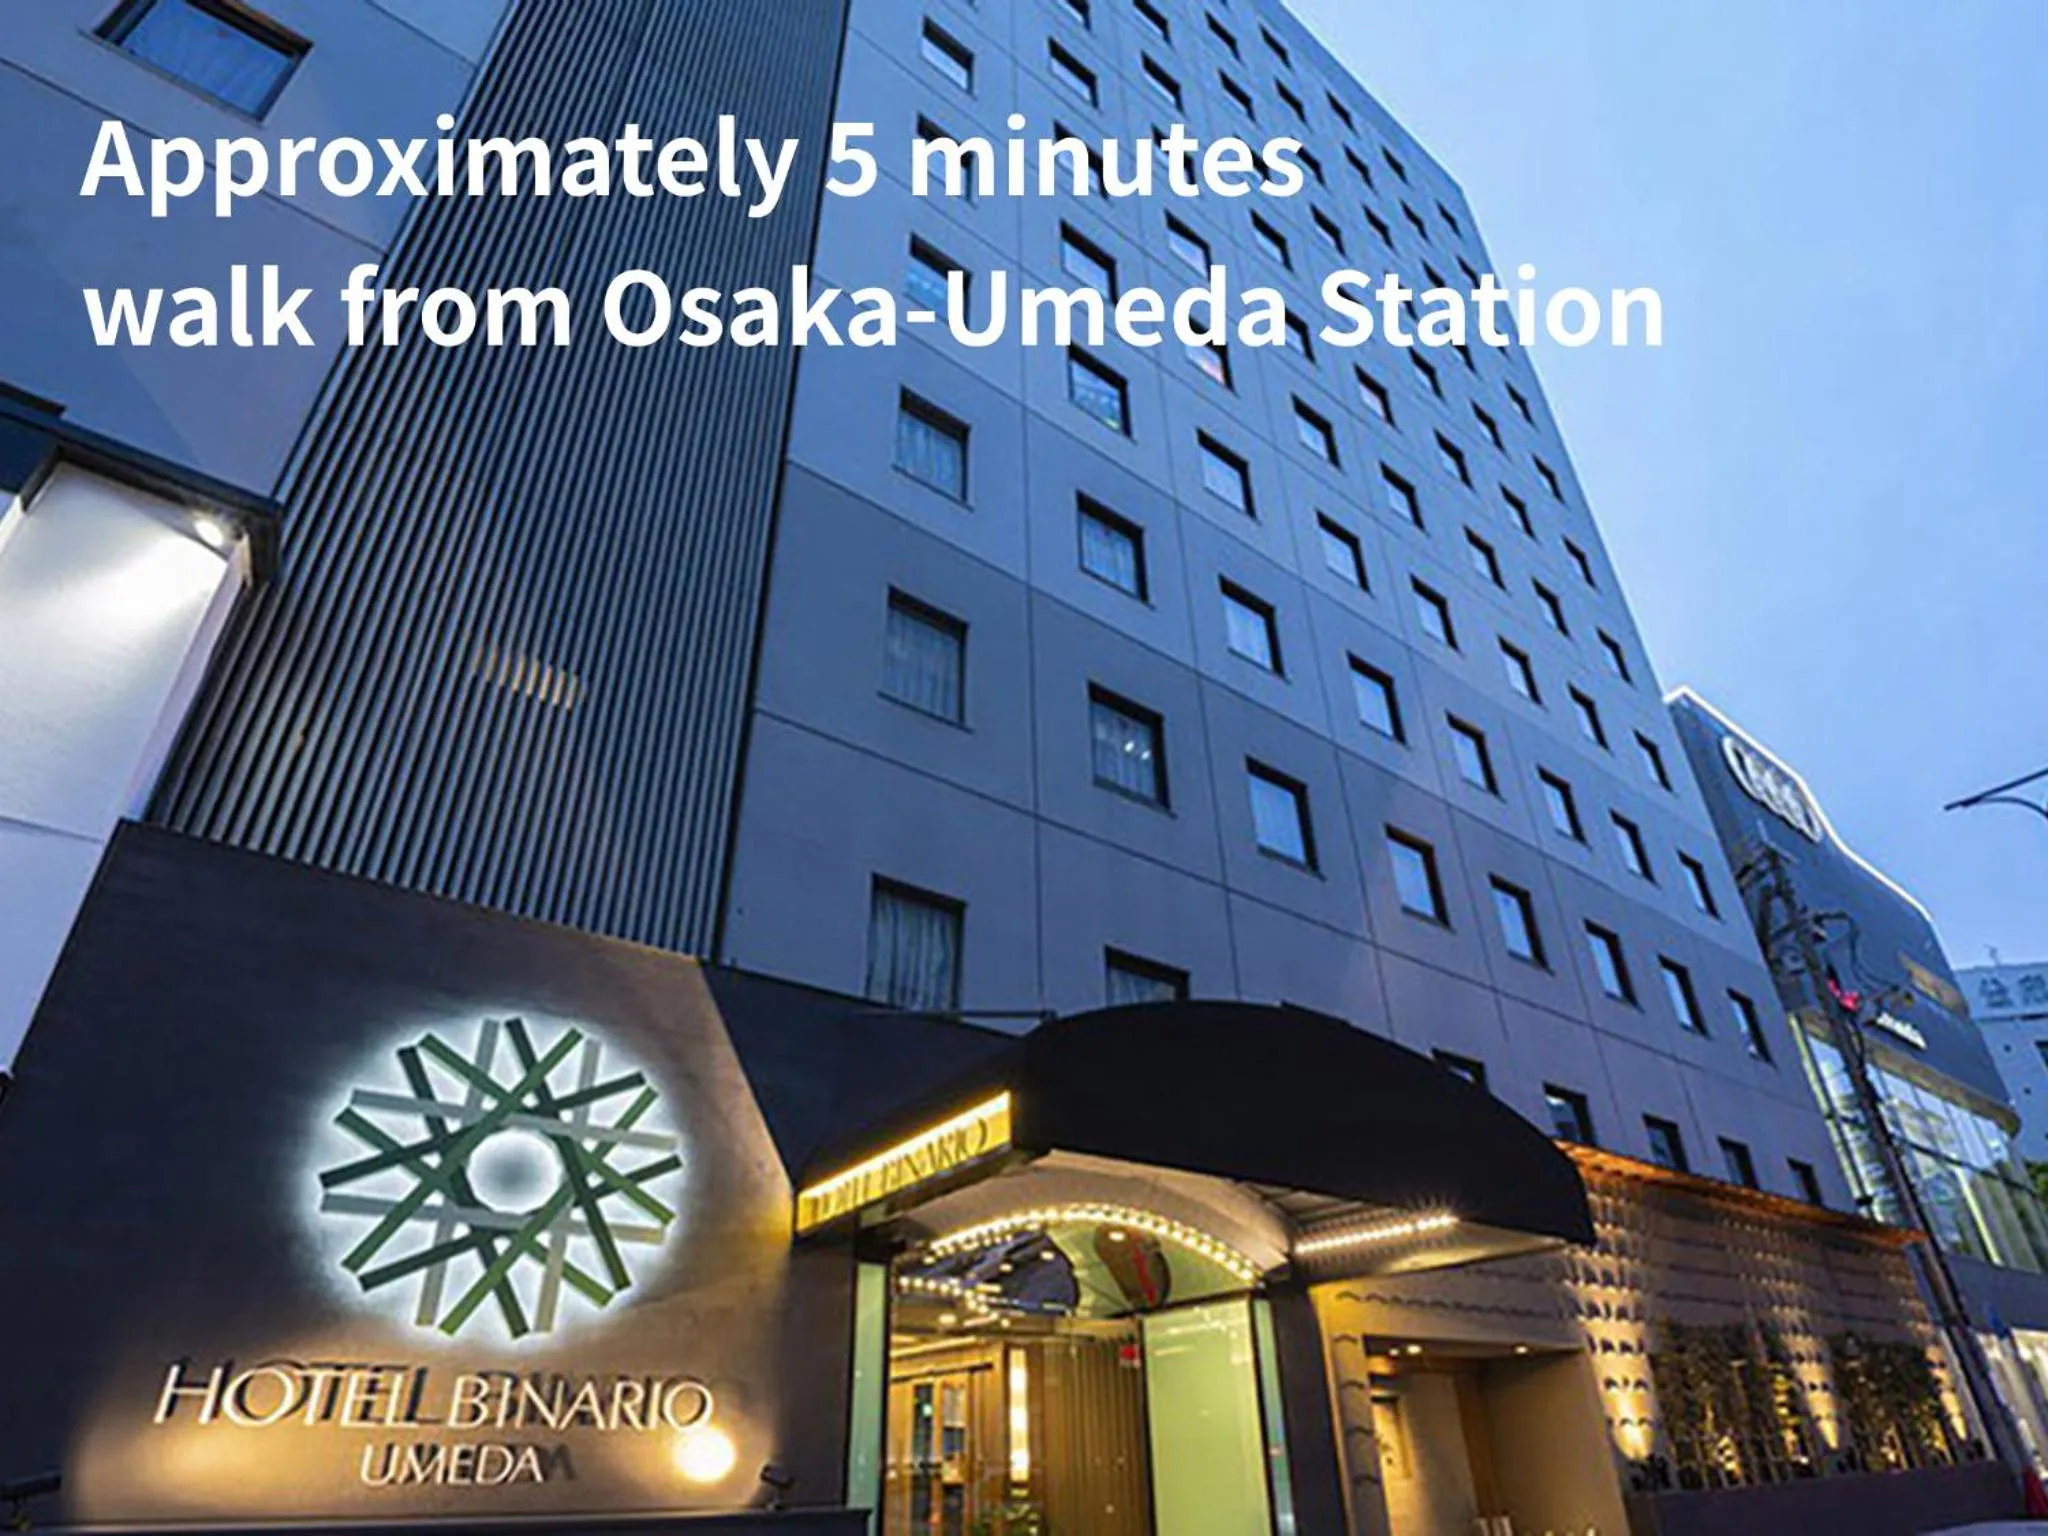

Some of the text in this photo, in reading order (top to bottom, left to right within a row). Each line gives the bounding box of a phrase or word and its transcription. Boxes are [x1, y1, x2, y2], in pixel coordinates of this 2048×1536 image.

[153, 1364, 714, 1431] HOTEL BINARIO
[360, 1443, 544, 1486] UMEDA
